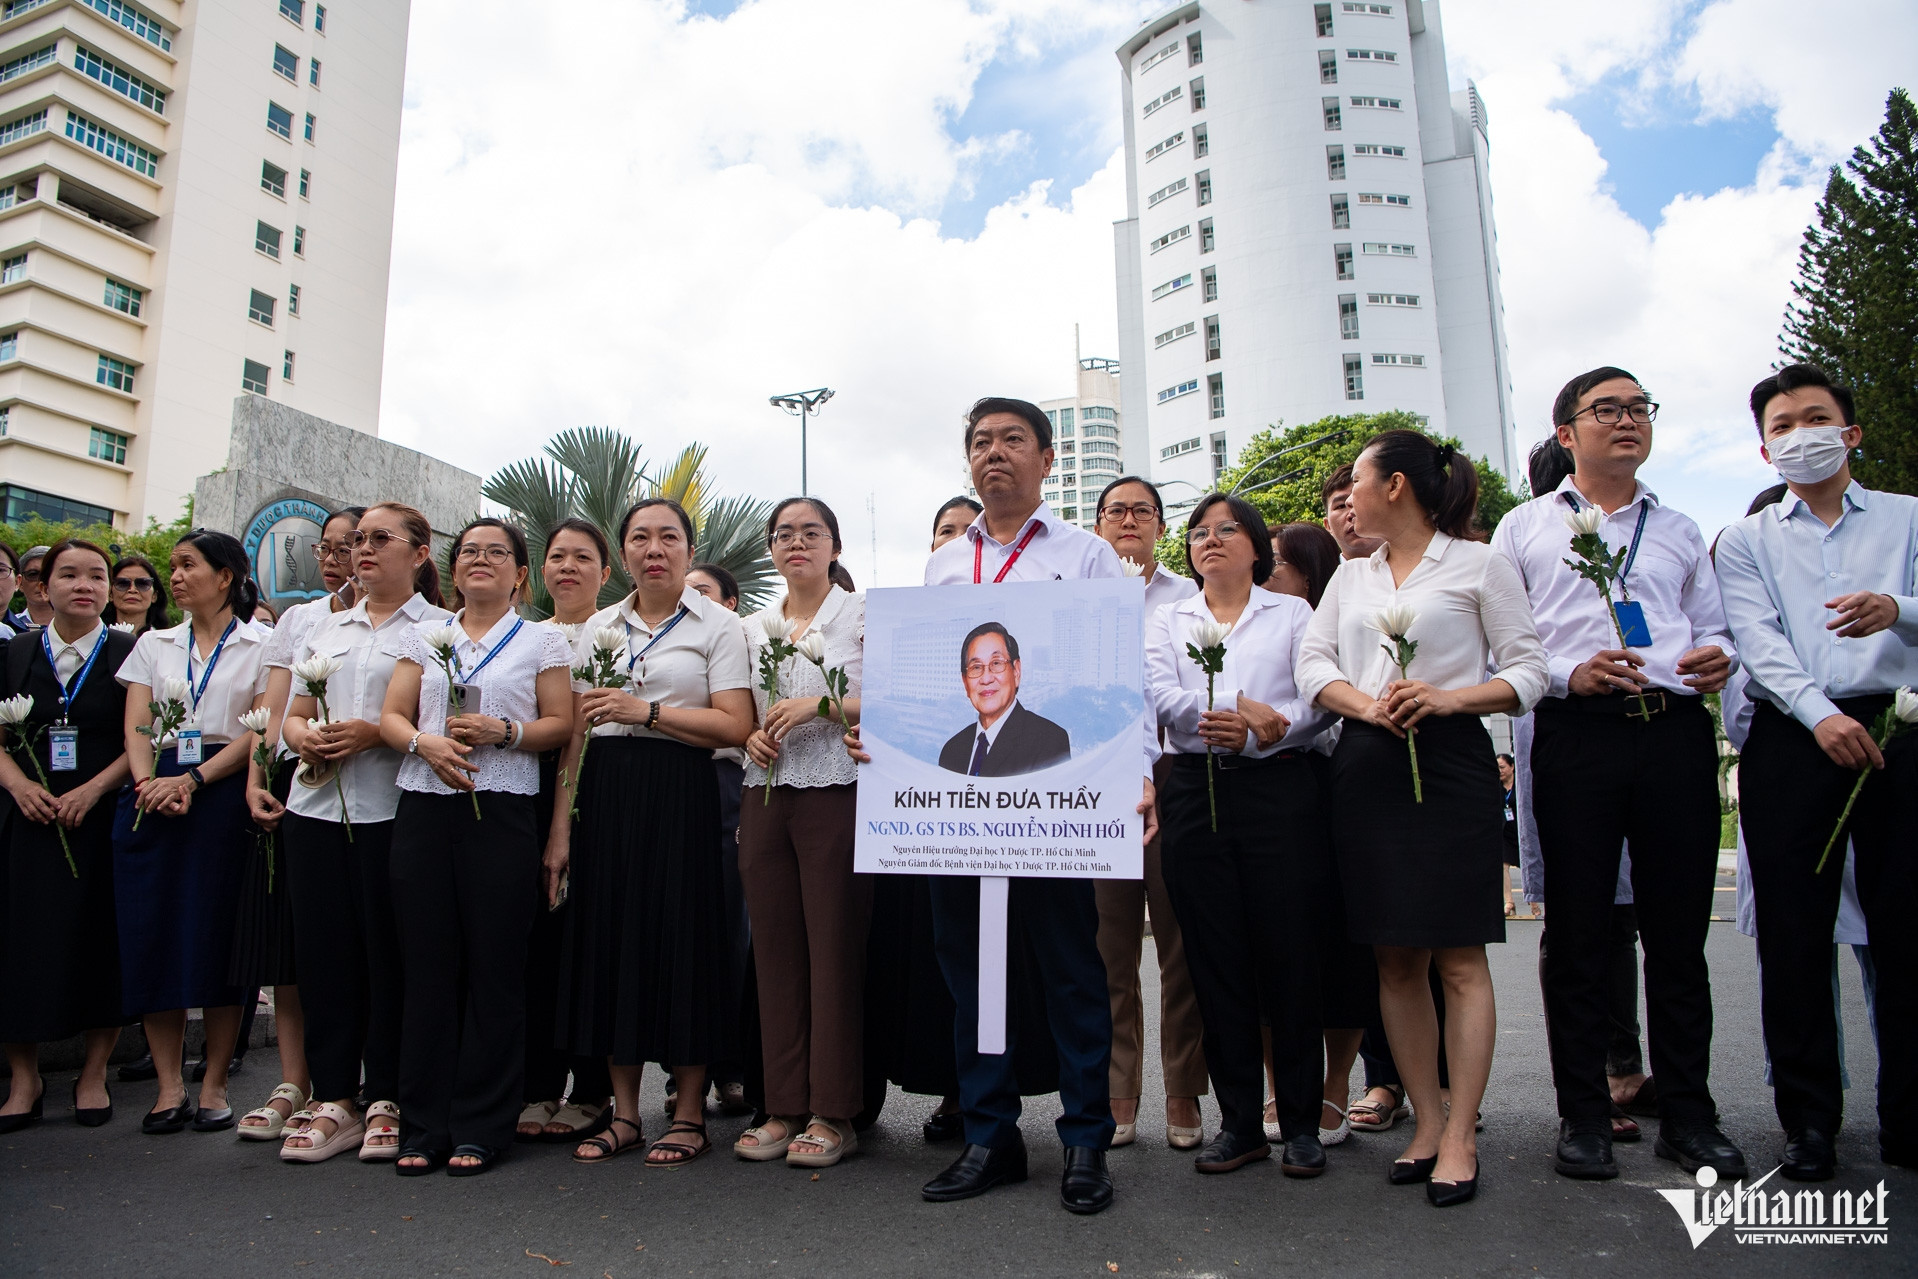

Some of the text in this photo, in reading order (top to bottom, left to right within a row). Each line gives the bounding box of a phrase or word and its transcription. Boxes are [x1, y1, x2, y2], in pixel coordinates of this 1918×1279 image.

[246, 538, 256, 549] Y
[284, 501, 325, 522] THÀNH
[895, 784, 1101, 809] KÍNH TIỄN ĐƯA THẦY
[868, 816, 1125, 838] NGND. GS TS BS. NGUYỄN ĐÌNH HỐI
[892, 845, 1096, 857] Nguyên Hiệu trưởng Đại học Y Dược TP. Hồ Chí Minh
[878, 858, 1111, 871] Nguyên Giám đốc Bệnh viện Đại học Y Dược TP. Hồ Chí Minh
